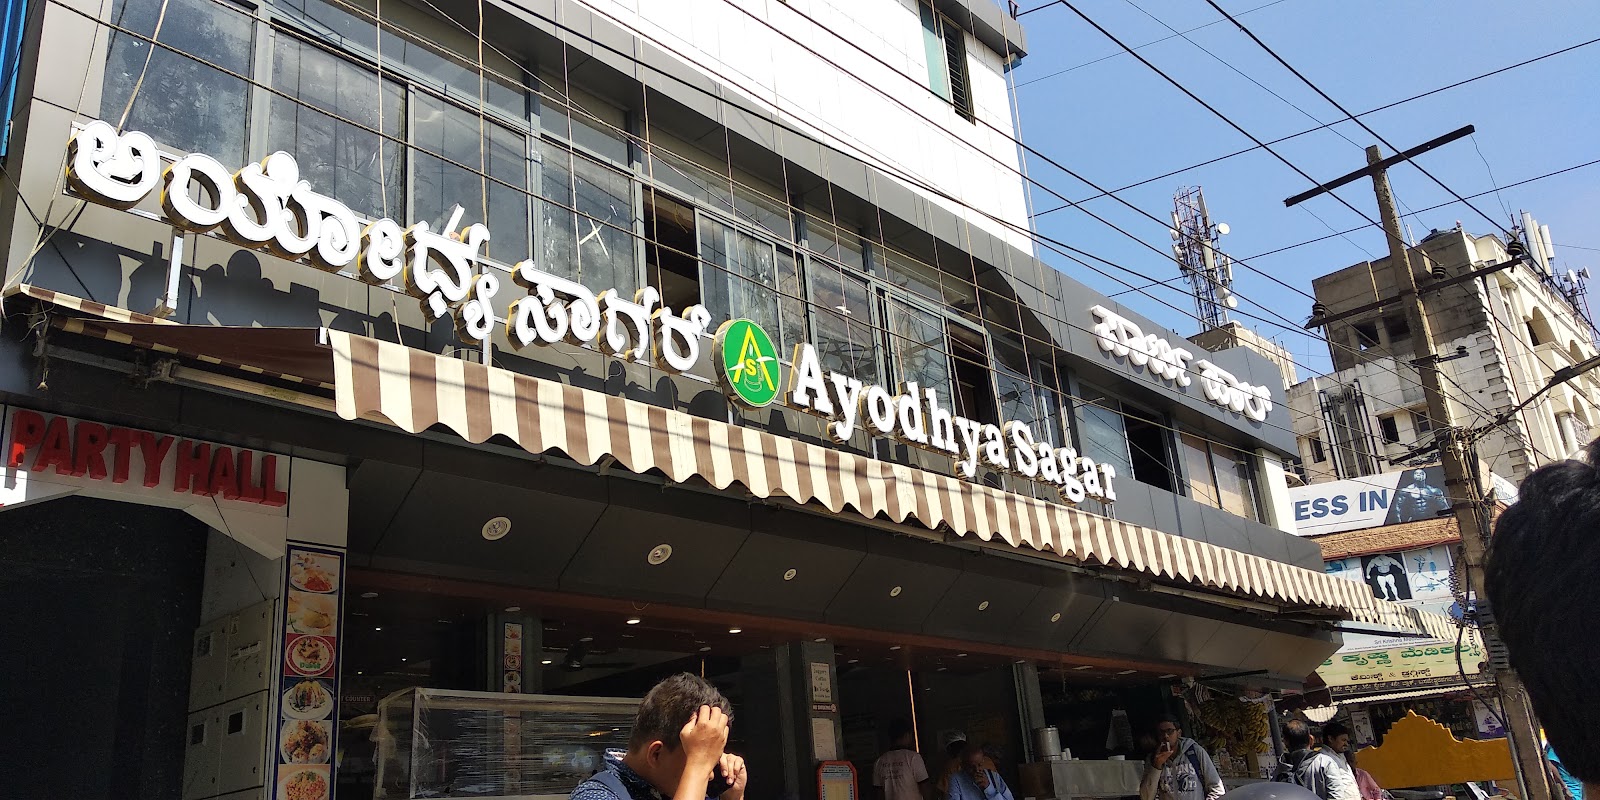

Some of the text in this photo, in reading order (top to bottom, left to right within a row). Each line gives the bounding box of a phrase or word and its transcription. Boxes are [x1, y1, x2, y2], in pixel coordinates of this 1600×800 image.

[507, 258, 712, 372] ಸಾಗರ್
[788, 342, 1117, 503] Ayodhya Sagar
[1195, 358, 1273, 422] ಹಾಲ್
[7, 410, 287, 507] PARTY HALL
[1291, 489, 1388, 521] ESS IN
